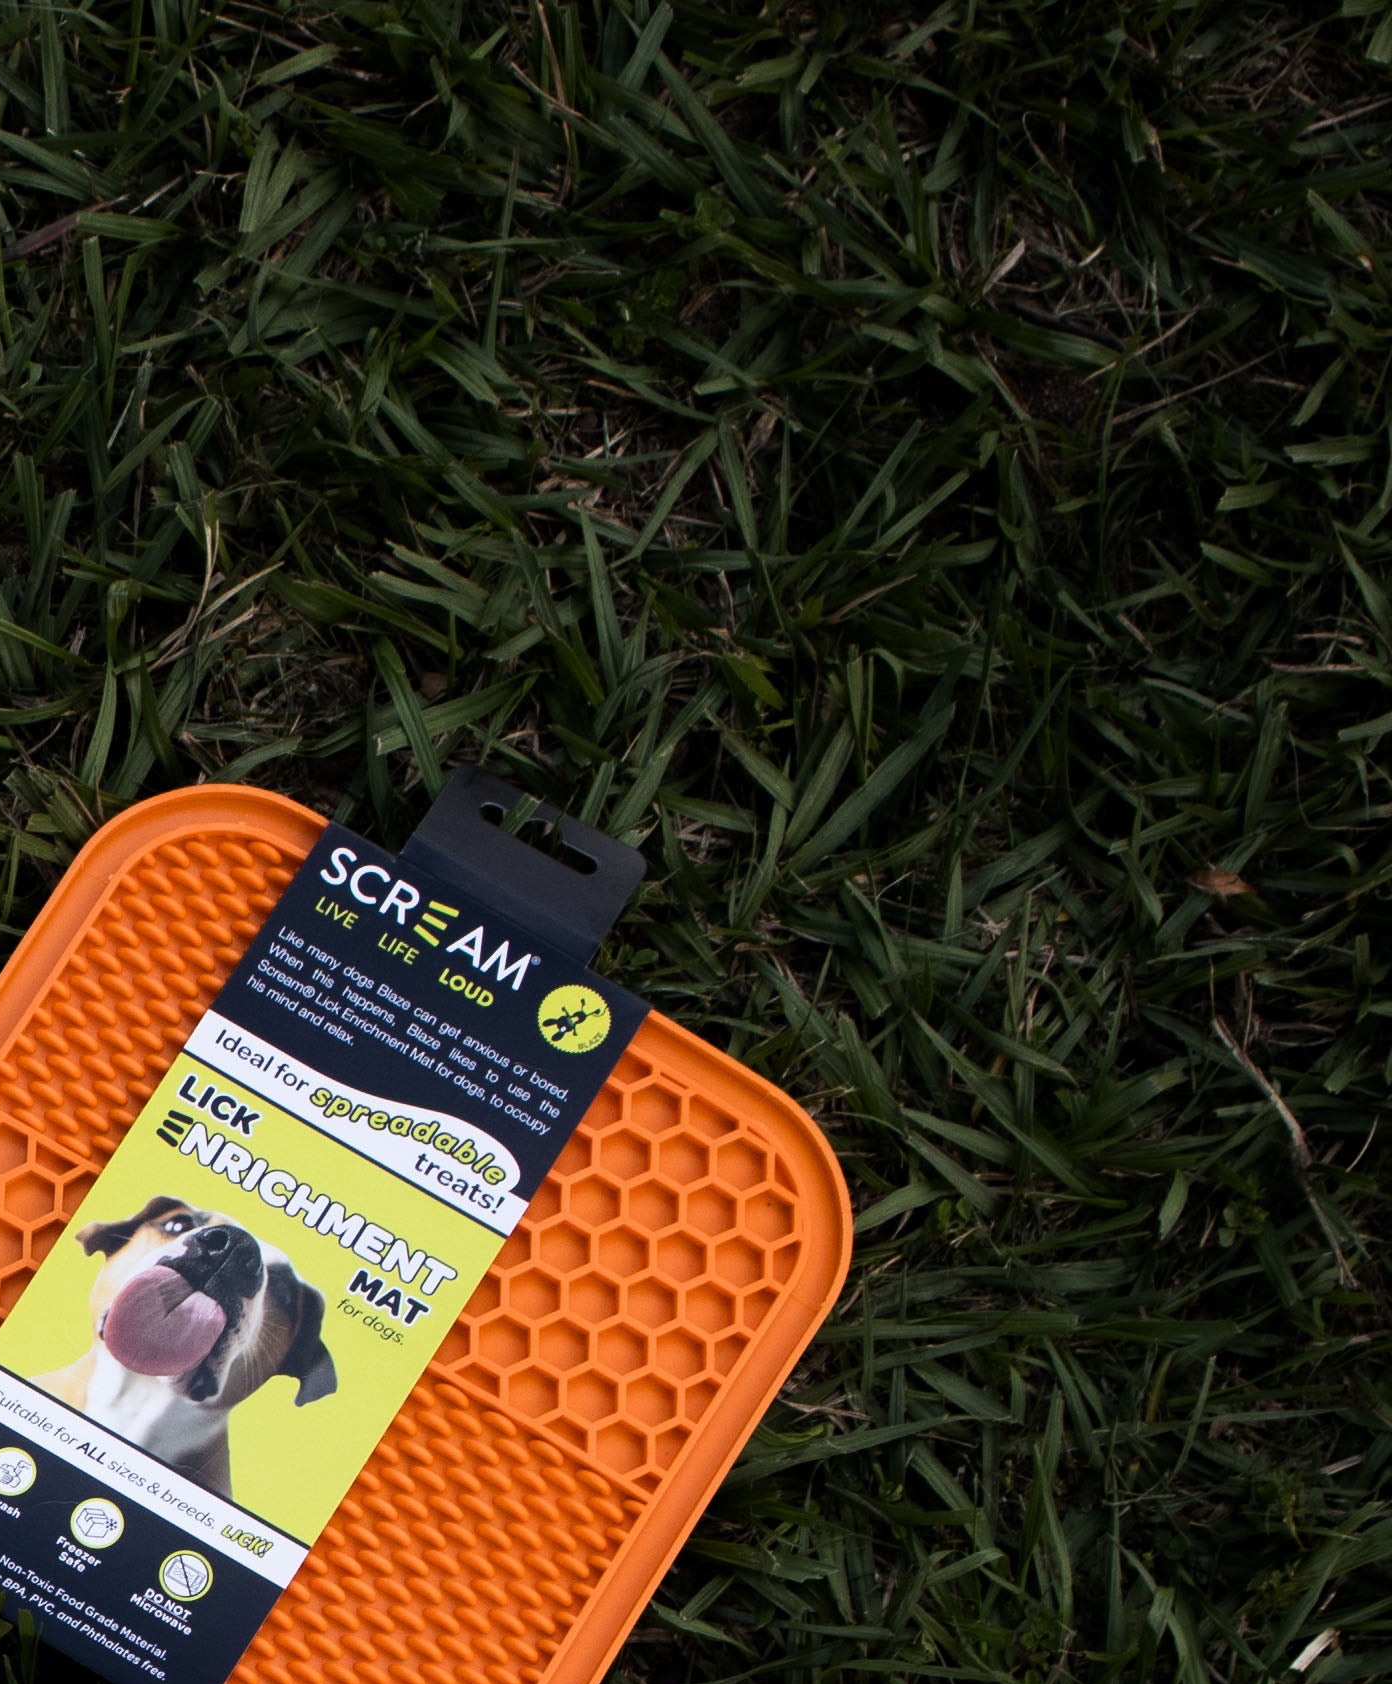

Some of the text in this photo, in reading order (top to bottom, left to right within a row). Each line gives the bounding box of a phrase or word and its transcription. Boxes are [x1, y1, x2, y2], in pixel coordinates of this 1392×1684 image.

[315, 896, 493, 1006] LIVE LIFE LOUD
[246, 974, 353, 1046] his mind and relax.
[269, 941, 303, 970] When
[311, 968, 334, 988] this
[406, 1022, 440, 1049] Blaze
[448, 1047, 476, 1070] likes
[484, 1068, 499, 1083] to
[507, 1083, 530, 1101] use
[539, 1099, 560, 1118] the
[278, 925, 304, 948] Like
[306, 944, 341, 970] many
[342, 966, 374, 989] dogs
[376, 983, 410, 1010] Blaze
[413, 1007, 437, 1025] can
[438, 1022, 461, 1039] get
[462, 1035, 510, 1067] anxious
[512, 1064, 528, 1076] or
[314, 991, 341, 1014] Lick
[340, 1007, 409, 1054] Enrichment
[409, 1046, 435, 1068] Mat
[434, 1061, 453, 1078] for
[453, 1074, 485, 1100] dogs,
[489, 1093, 503, 1108] to
[504, 1103, 550, 1135] occupy
[178, 1075, 259, 1134] LICK
[215, 1028, 506, 1186] Ideal for spreadable
[155, 1109, 458, 1296] ENRICHMENT
[414, 1153, 505, 1214] treats!
[336, 1298, 403, 1345] for dogs.
[349, 1270, 428, 1324] MAT
[53, 1426, 78, 1444] for
[75, 1441, 106, 1464] ALL
[107, 1460, 146, 1486] sizes
[146, 1482, 160, 1495] &
[159, 1488, 214, 1529] breeds.
[220, 1524, 274, 1558] LICK!
[55, 1535, 101, 1566] Freezer
[58, 1551, 85, 1572] Safe
[1, 1577, 26, 1598] BPA,
[28, 1593, 55, 1615] PVC,
[56, 1611, 82, 1628] and
[79, 1623, 138, 1664] Phthalates
[135, 1657, 165, 1680] free.
[54, 1587, 85, 1610] Food
[84, 1605, 119, 1631] Grade
[119, 1625, 166, 1660] Material.
[129, 1593, 191, 1635] Microwave
[142, 1587, 191, 1622] DO NOT
